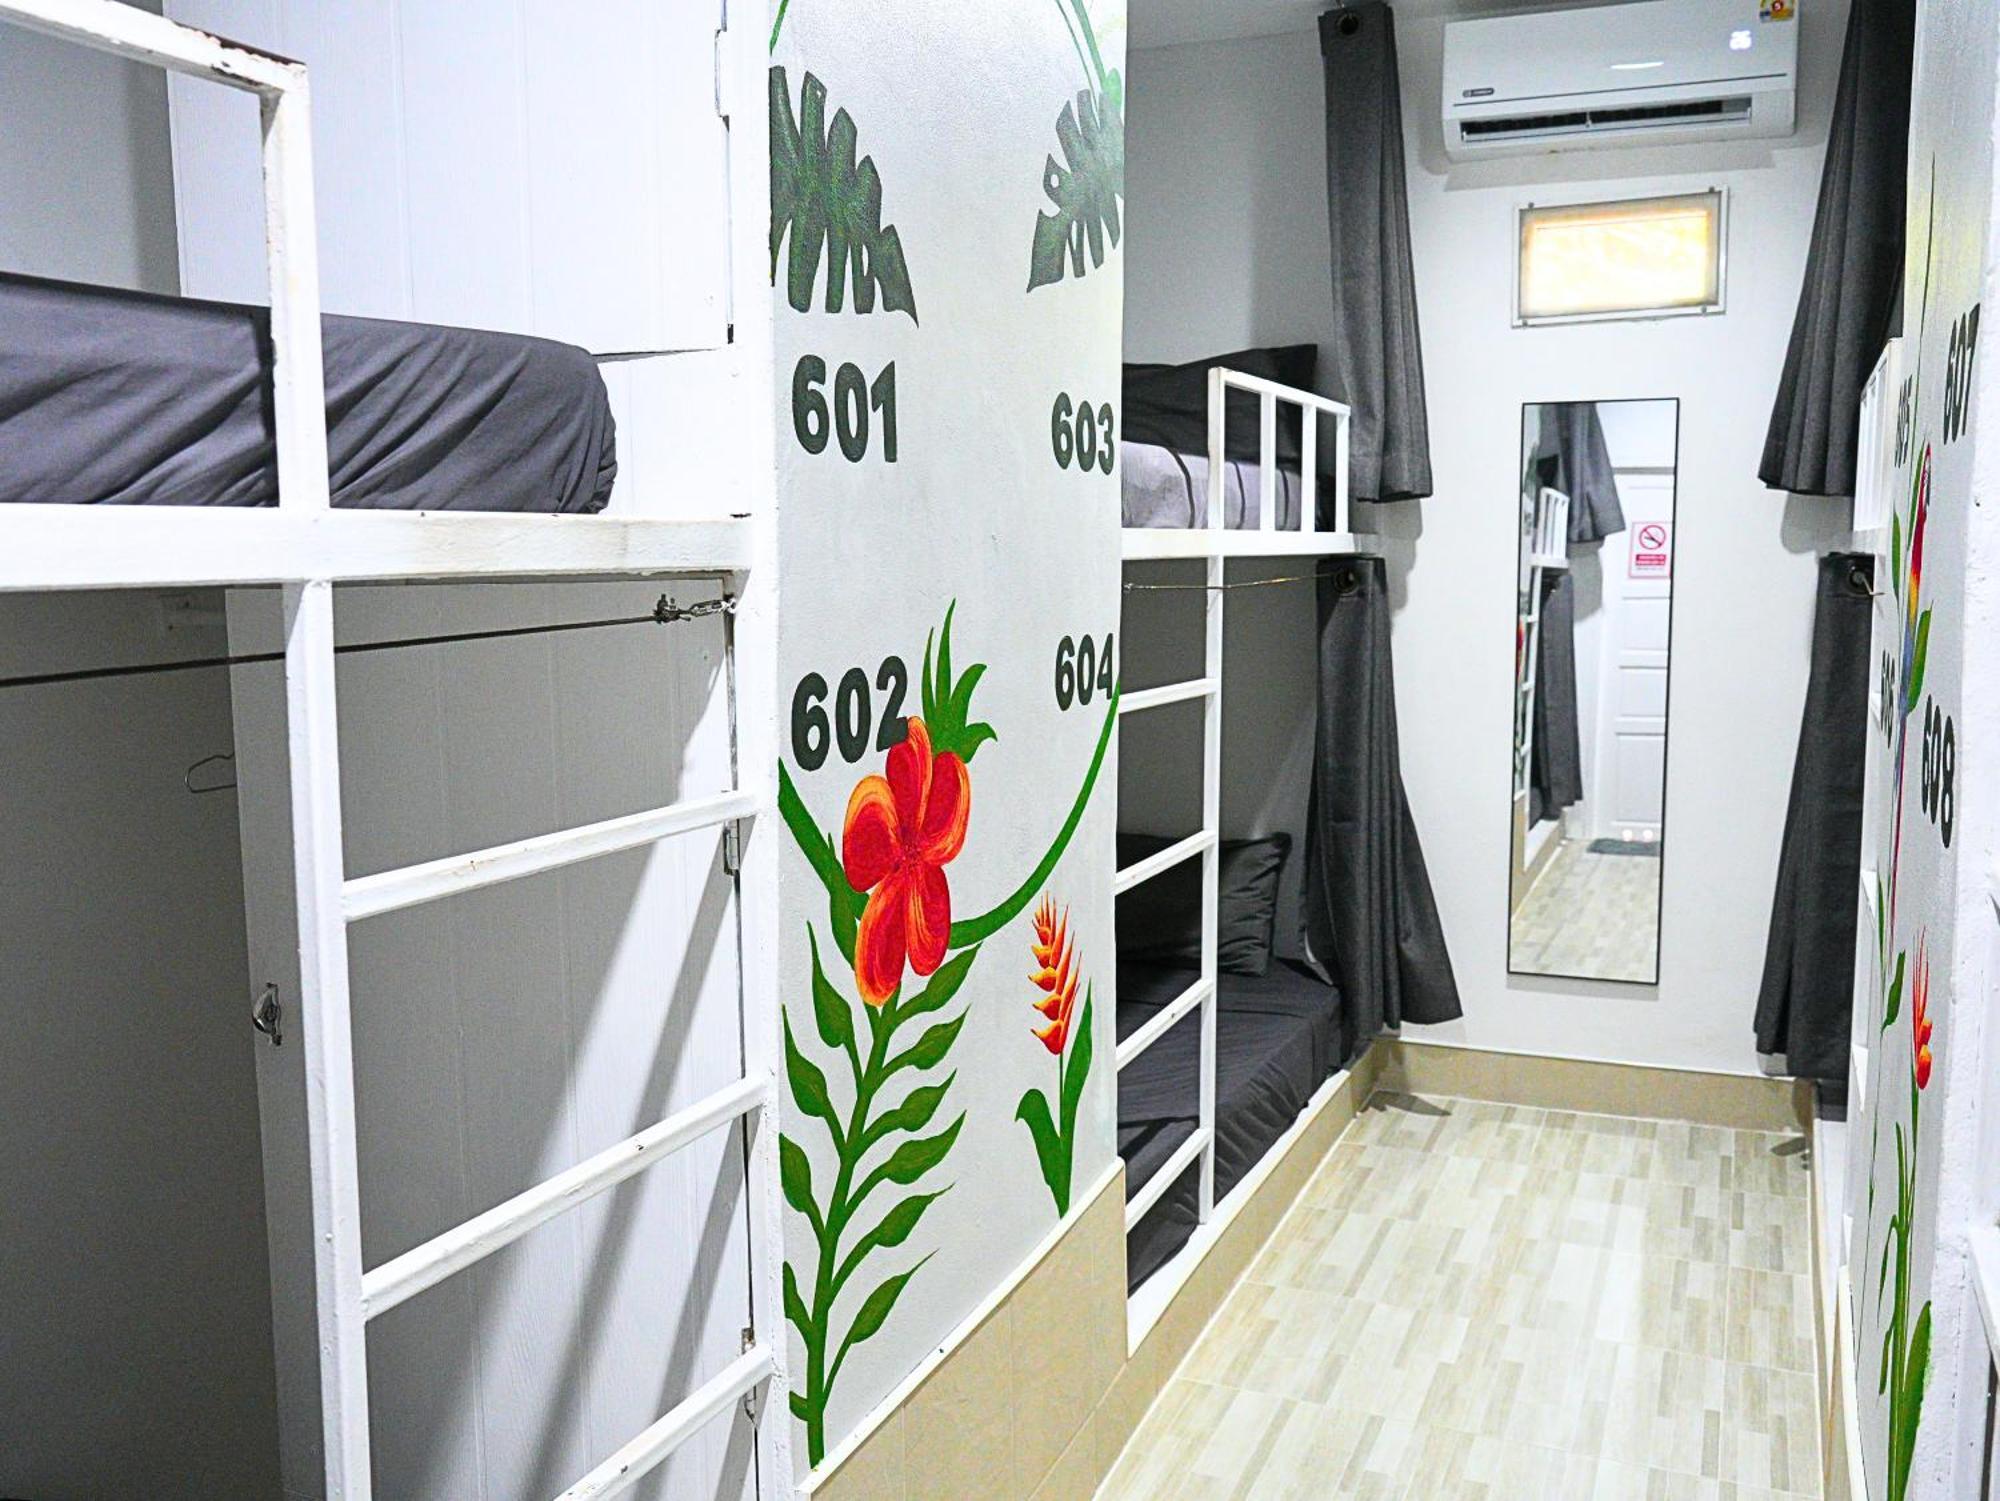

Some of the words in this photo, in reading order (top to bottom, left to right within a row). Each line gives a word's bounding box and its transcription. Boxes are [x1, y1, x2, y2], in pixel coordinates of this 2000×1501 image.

[792, 354, 897, 462] 601
[1943, 302, 1980, 445] 607
[1052, 392, 1114, 475] 603
[791, 655, 908, 771] 602
[1055, 633, 1114, 711] 604
[1922, 694, 1955, 849] 608
